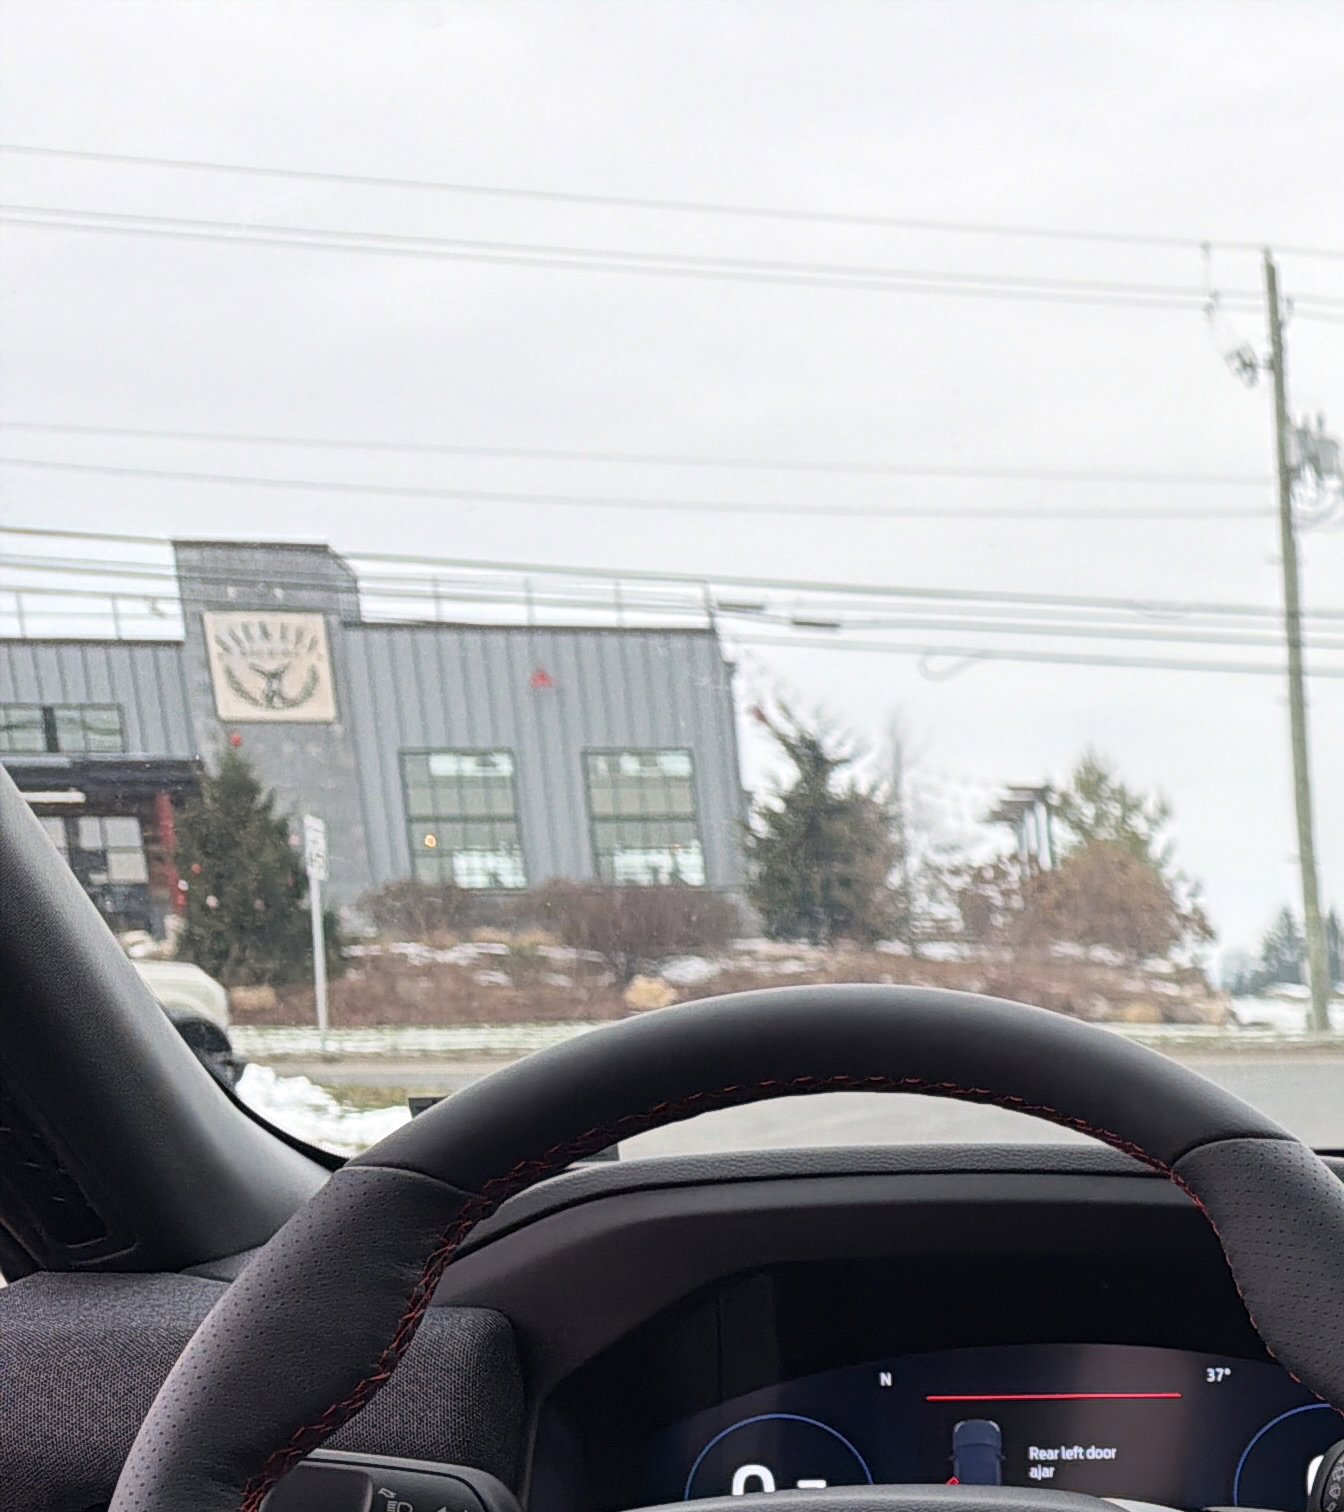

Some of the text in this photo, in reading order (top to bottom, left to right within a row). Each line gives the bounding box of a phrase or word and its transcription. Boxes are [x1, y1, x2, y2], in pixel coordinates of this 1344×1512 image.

[880, 1372, 892, 1387] N
[1206, 1368, 1231, 1383] 37°
[1029, 1446, 1117, 1460] Rear left door
[1029, 1465, 1055, 1480] ajar
